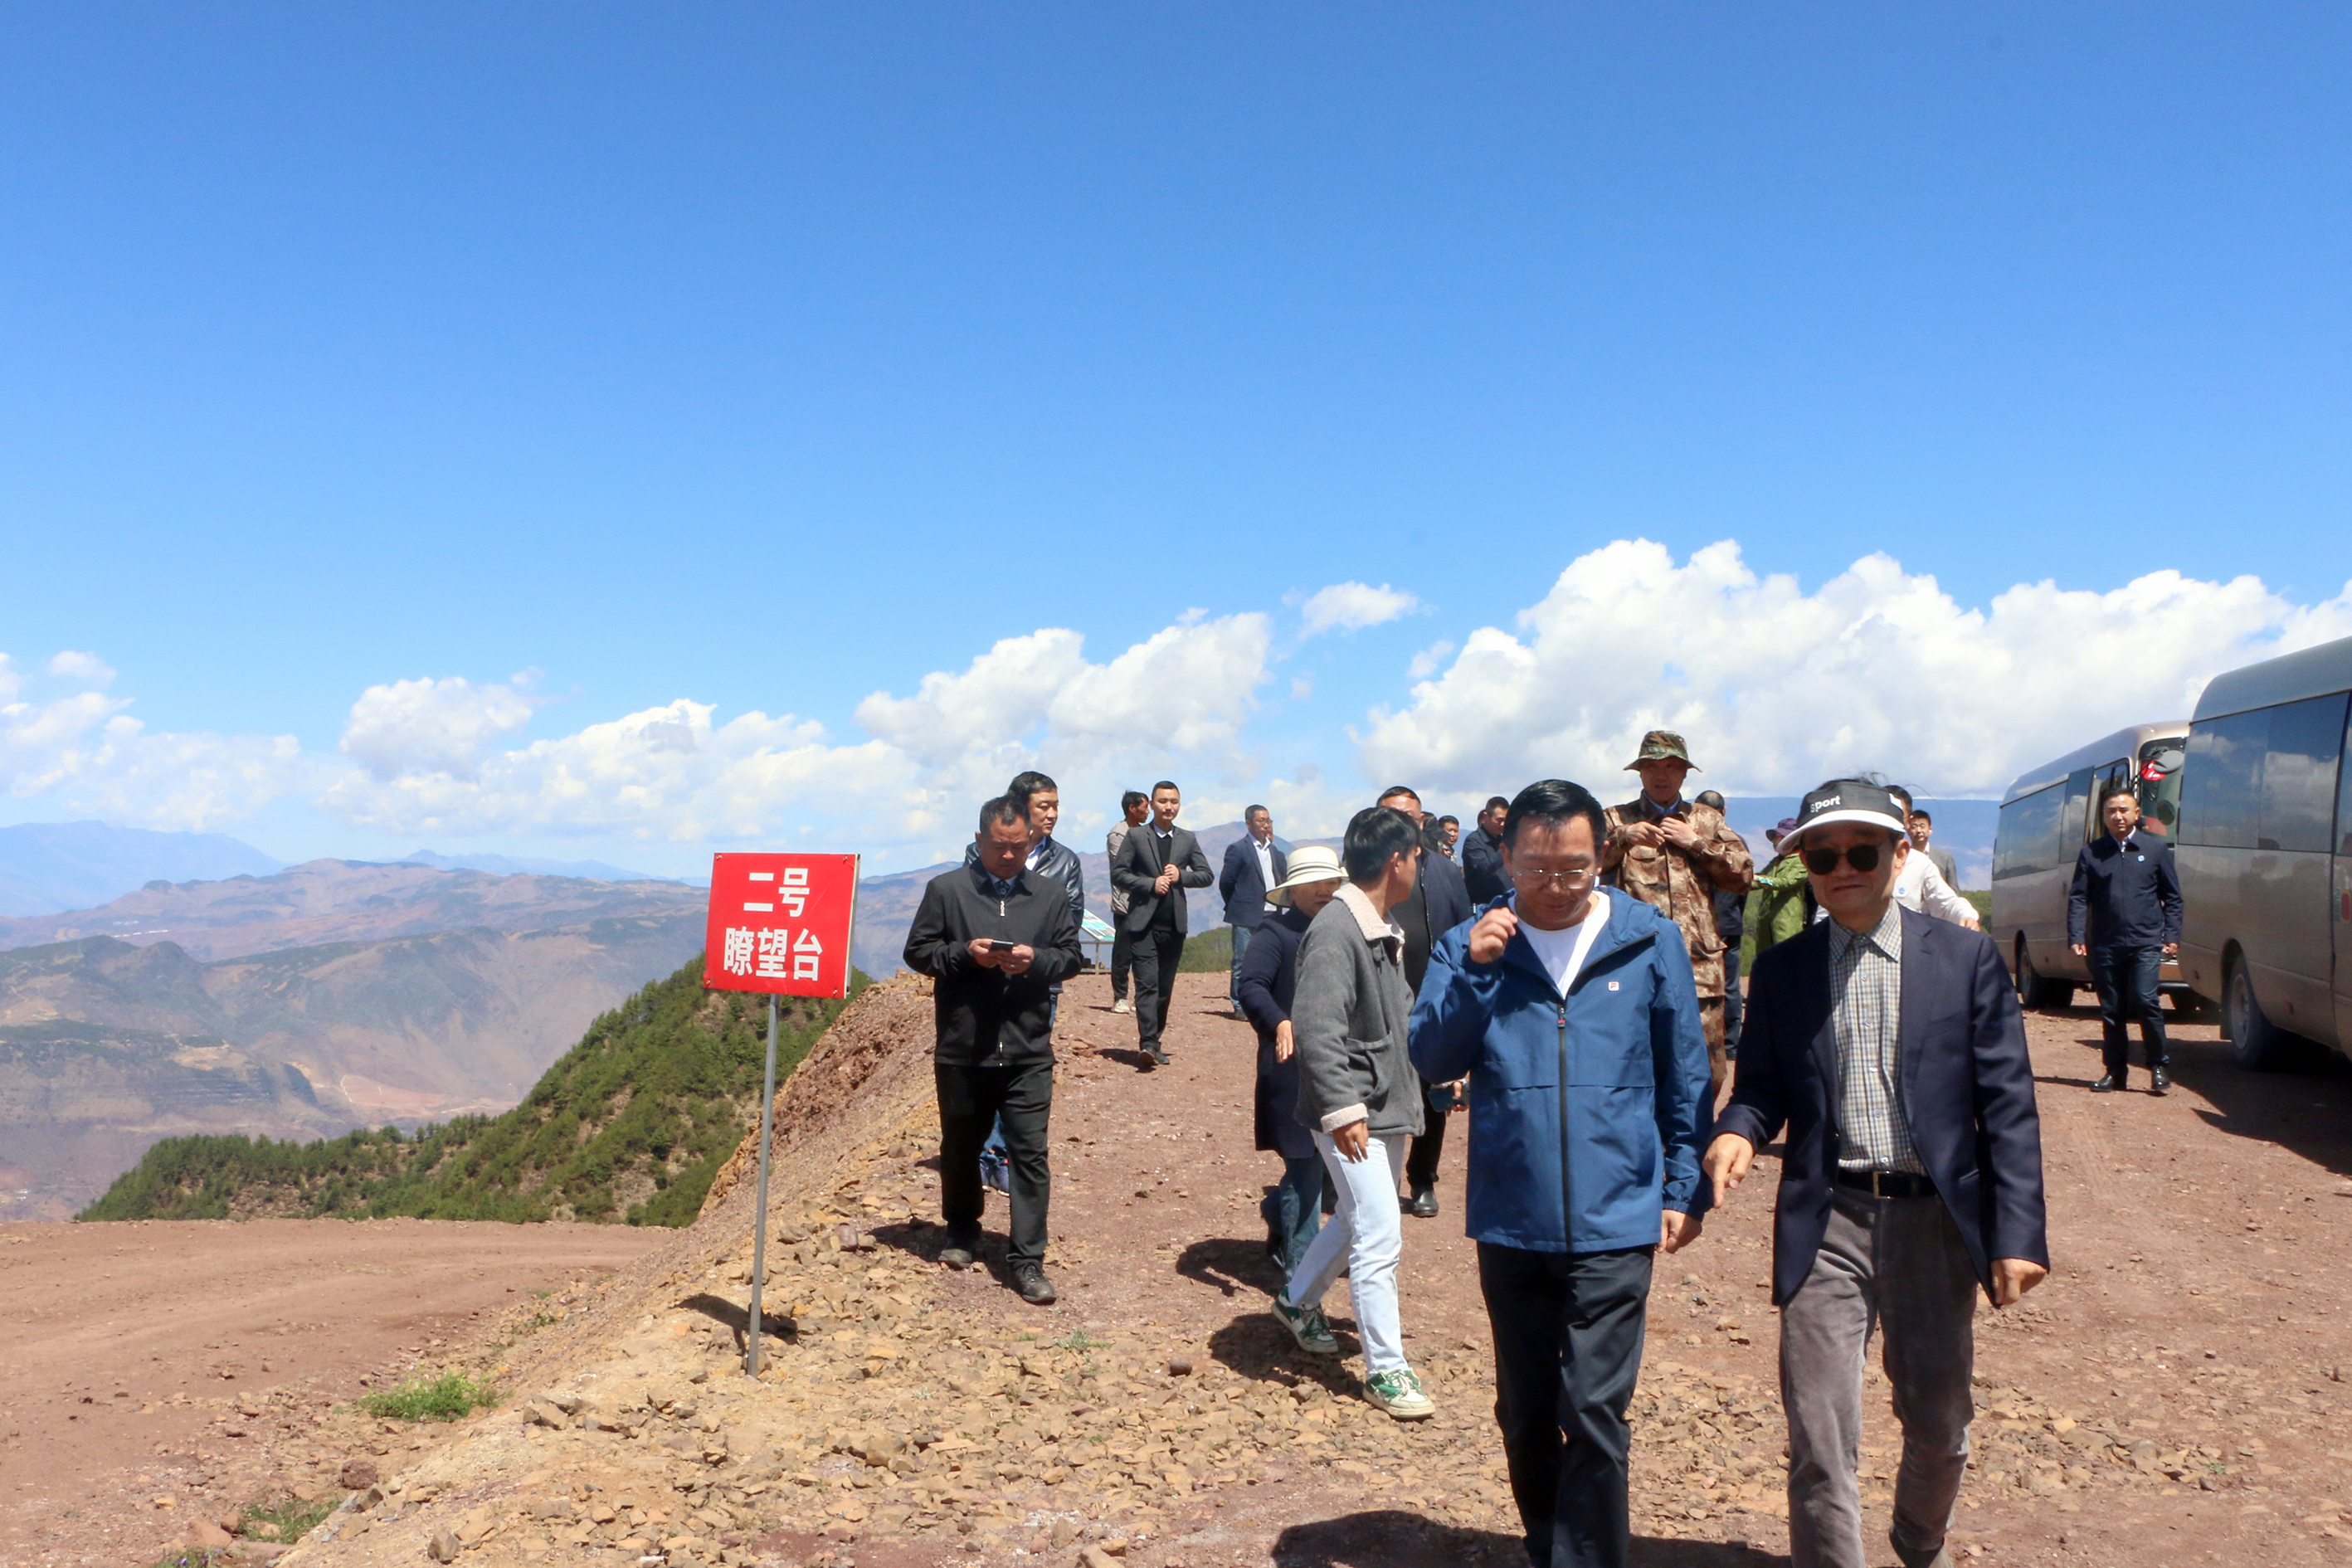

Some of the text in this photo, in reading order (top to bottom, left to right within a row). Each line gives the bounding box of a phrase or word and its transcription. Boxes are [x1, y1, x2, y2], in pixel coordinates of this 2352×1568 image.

[743, 867, 810, 918] 二号
[723, 926, 823, 981] 瞭望台
